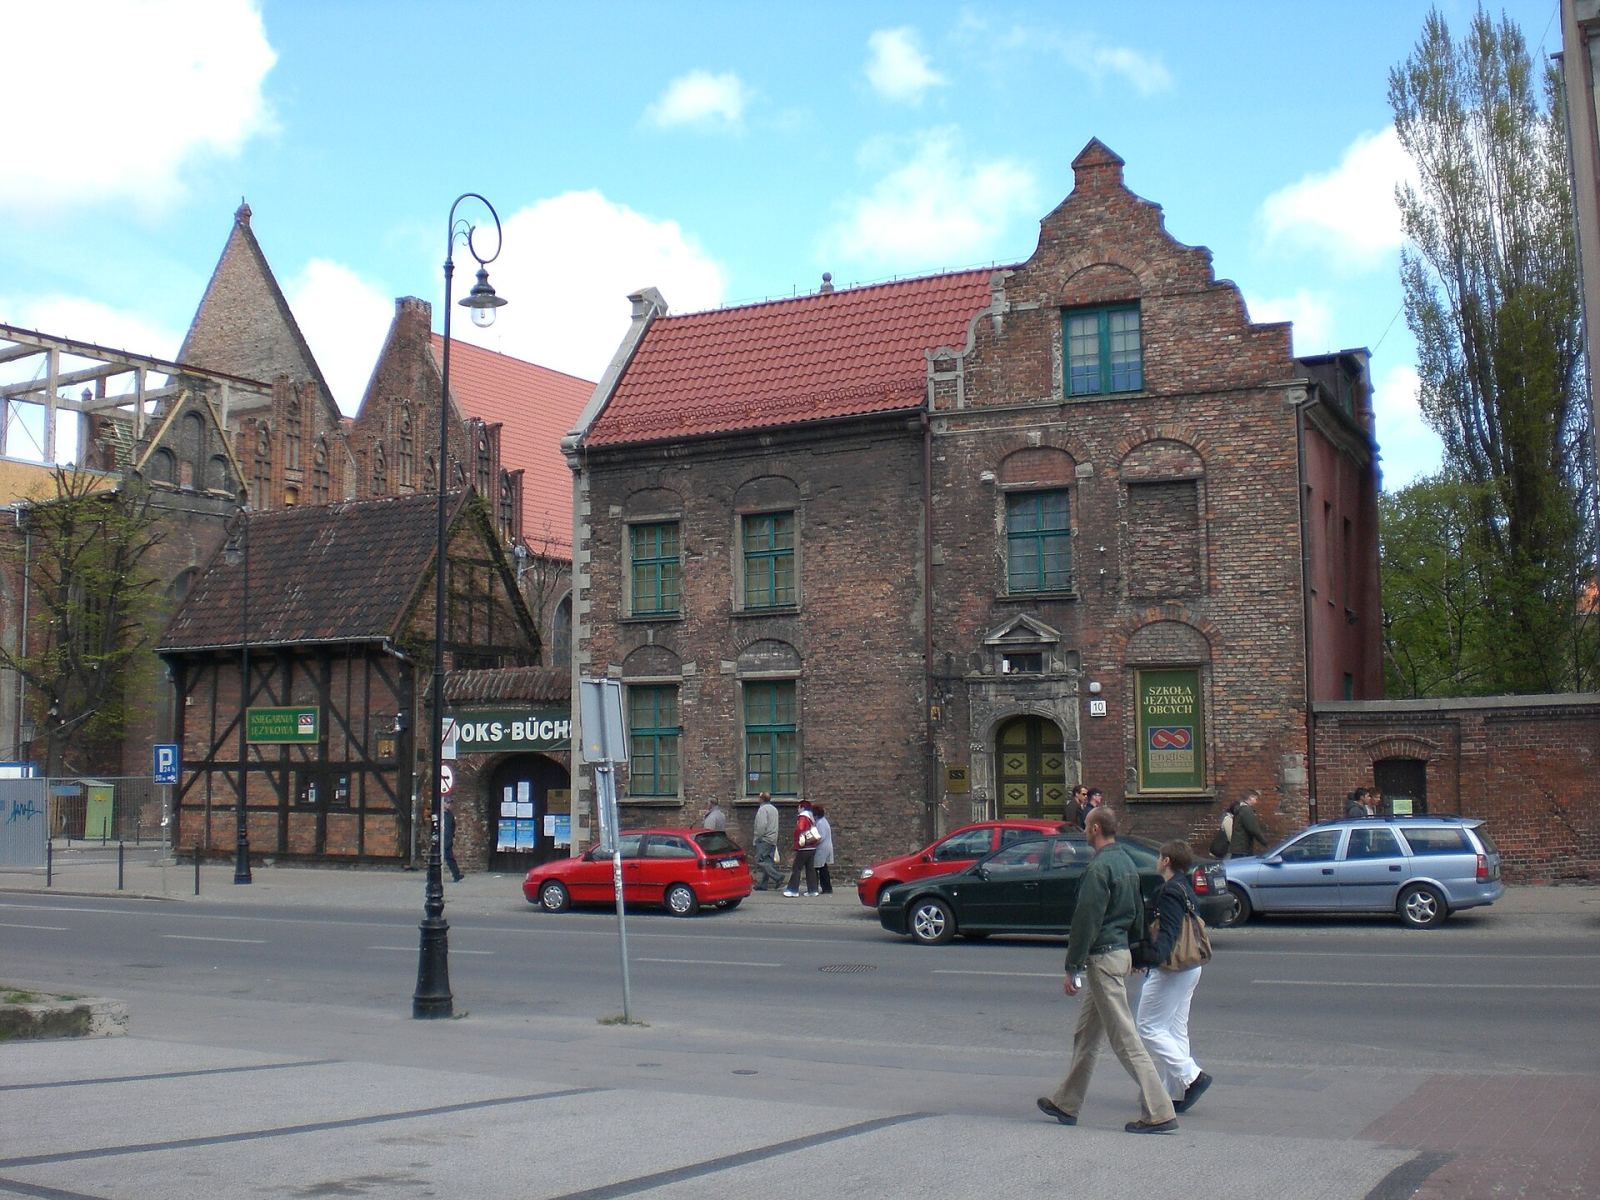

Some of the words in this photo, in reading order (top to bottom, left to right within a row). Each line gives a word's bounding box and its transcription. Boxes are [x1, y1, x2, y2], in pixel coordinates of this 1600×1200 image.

[1149, 686, 1192, 696] SZKOŁA
[1144, 694, 1195, 706] JĘZYKÓW
[1092, 702, 1104, 712] 10
[1148, 705, 1192, 715] OBCYCH
[511, 717, 571, 741] BÜCH
[159, 748, 173, 773] P
